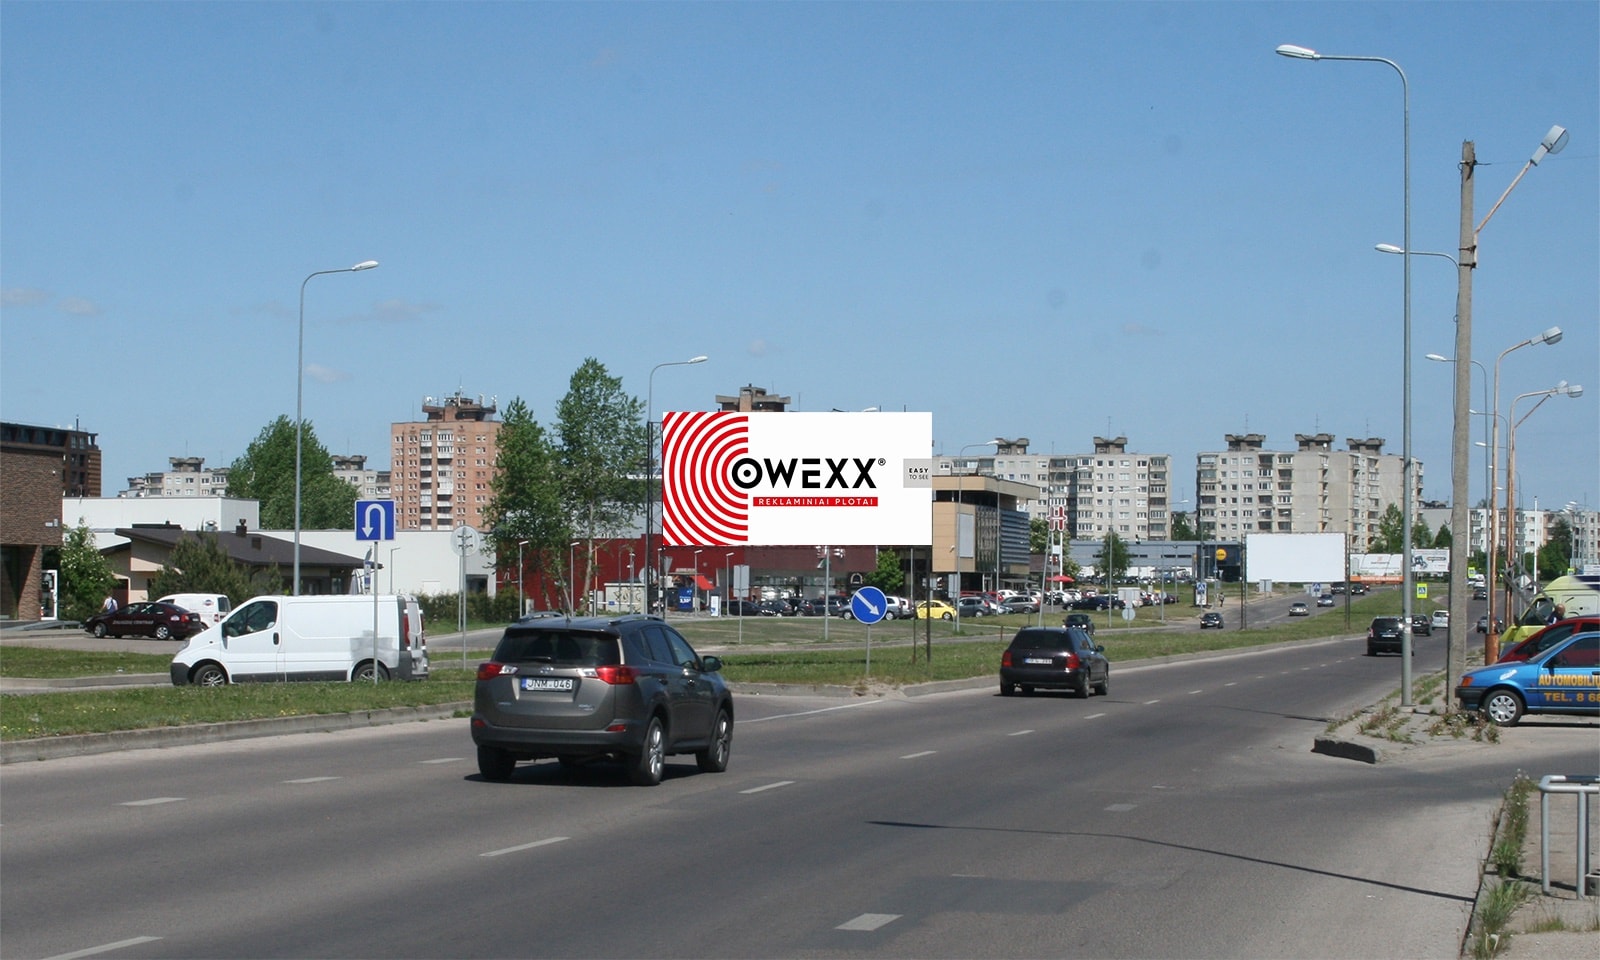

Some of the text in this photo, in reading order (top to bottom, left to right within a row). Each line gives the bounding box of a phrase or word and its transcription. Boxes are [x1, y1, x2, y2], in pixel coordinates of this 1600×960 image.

[758, 498, 873, 506] REKLAMINIAI PLOTAI
[1544, 692, 1572, 702] TEL.
[1576, 692, 1584, 702] 8
